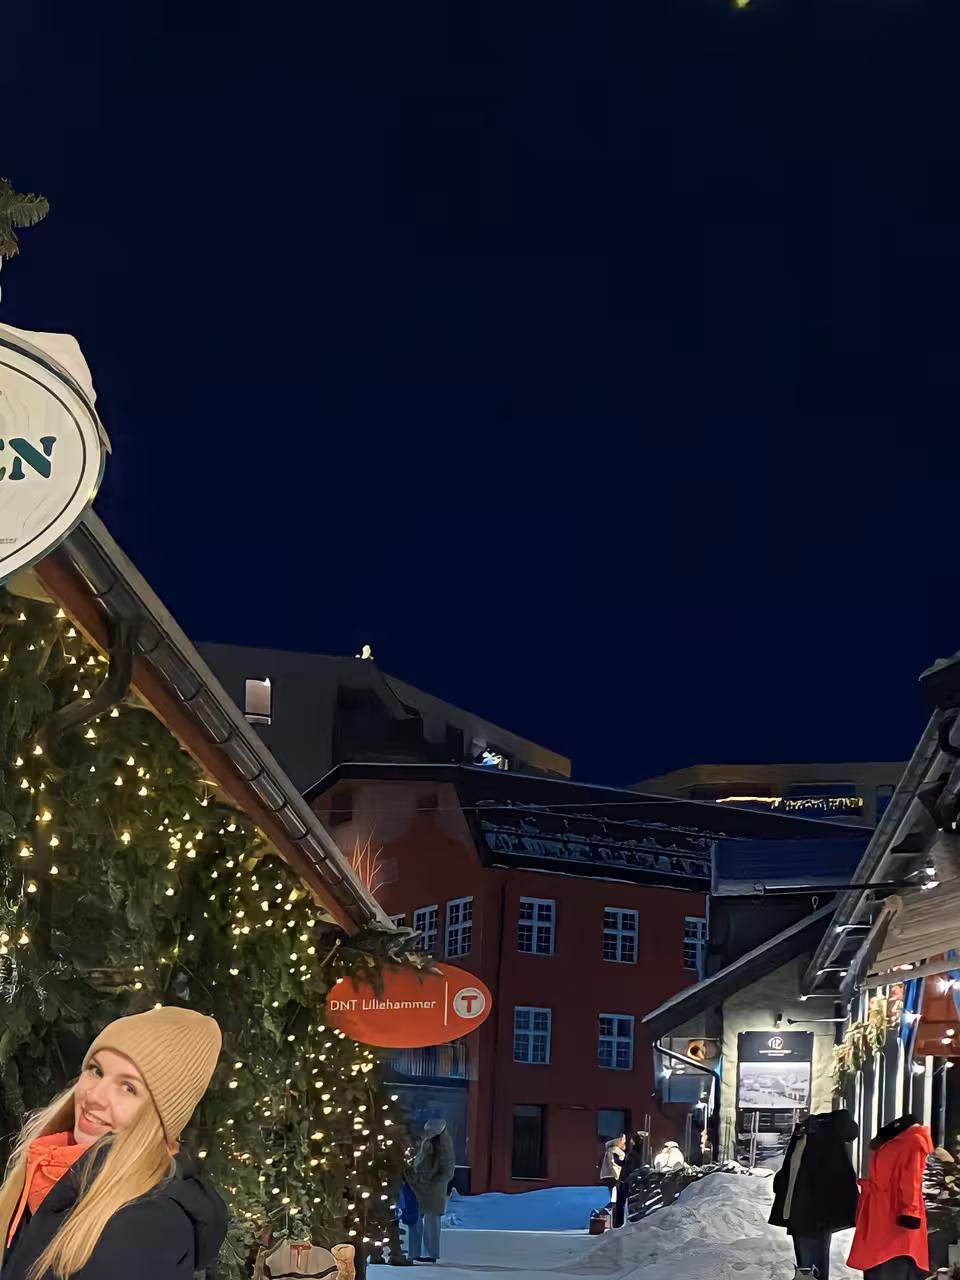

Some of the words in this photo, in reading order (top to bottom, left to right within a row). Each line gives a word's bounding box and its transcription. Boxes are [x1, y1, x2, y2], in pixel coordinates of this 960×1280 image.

[329, 999, 358, 1012] DNT
[361, 998, 437, 1011] Lillehammer
[460, 995, 479, 1014] T
